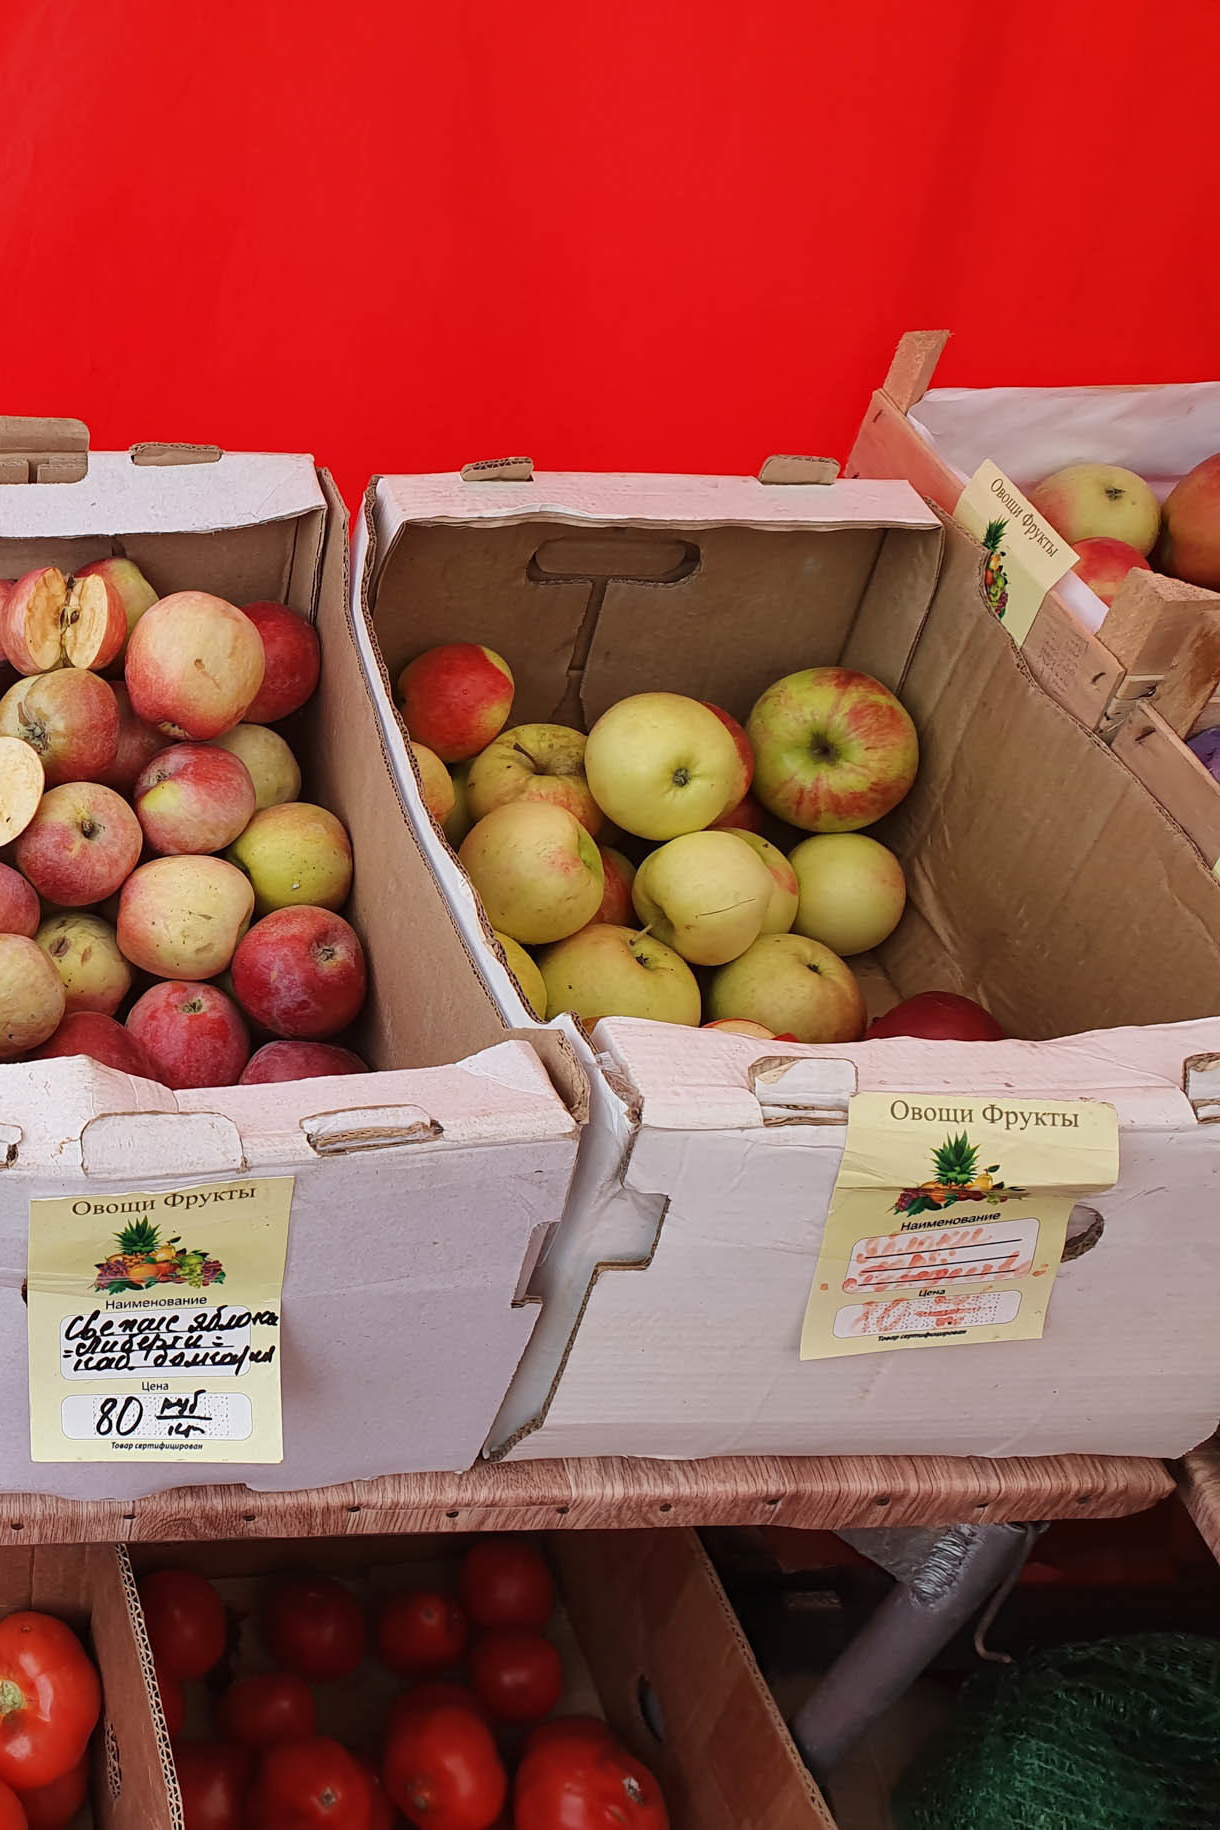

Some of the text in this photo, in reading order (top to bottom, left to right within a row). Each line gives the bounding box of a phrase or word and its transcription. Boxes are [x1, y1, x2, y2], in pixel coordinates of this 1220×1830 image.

[990, 478, 1059, 557] Овощи Фрукты
[890, 1100, 1079, 1131] Овощи Фрукты
[72, 1186, 258, 1216] Овощи Фрукты
[900, 1212, 1001, 1231] Наименование
[918, 1288, 946, 1297] Цена
[105, 1295, 208, 1310] Наименование
[141, 1381, 170, 1392] Цена
[95, 1395, 144, 1437] 80
[110, 1441, 203, 1452] Товар сертифицирован
